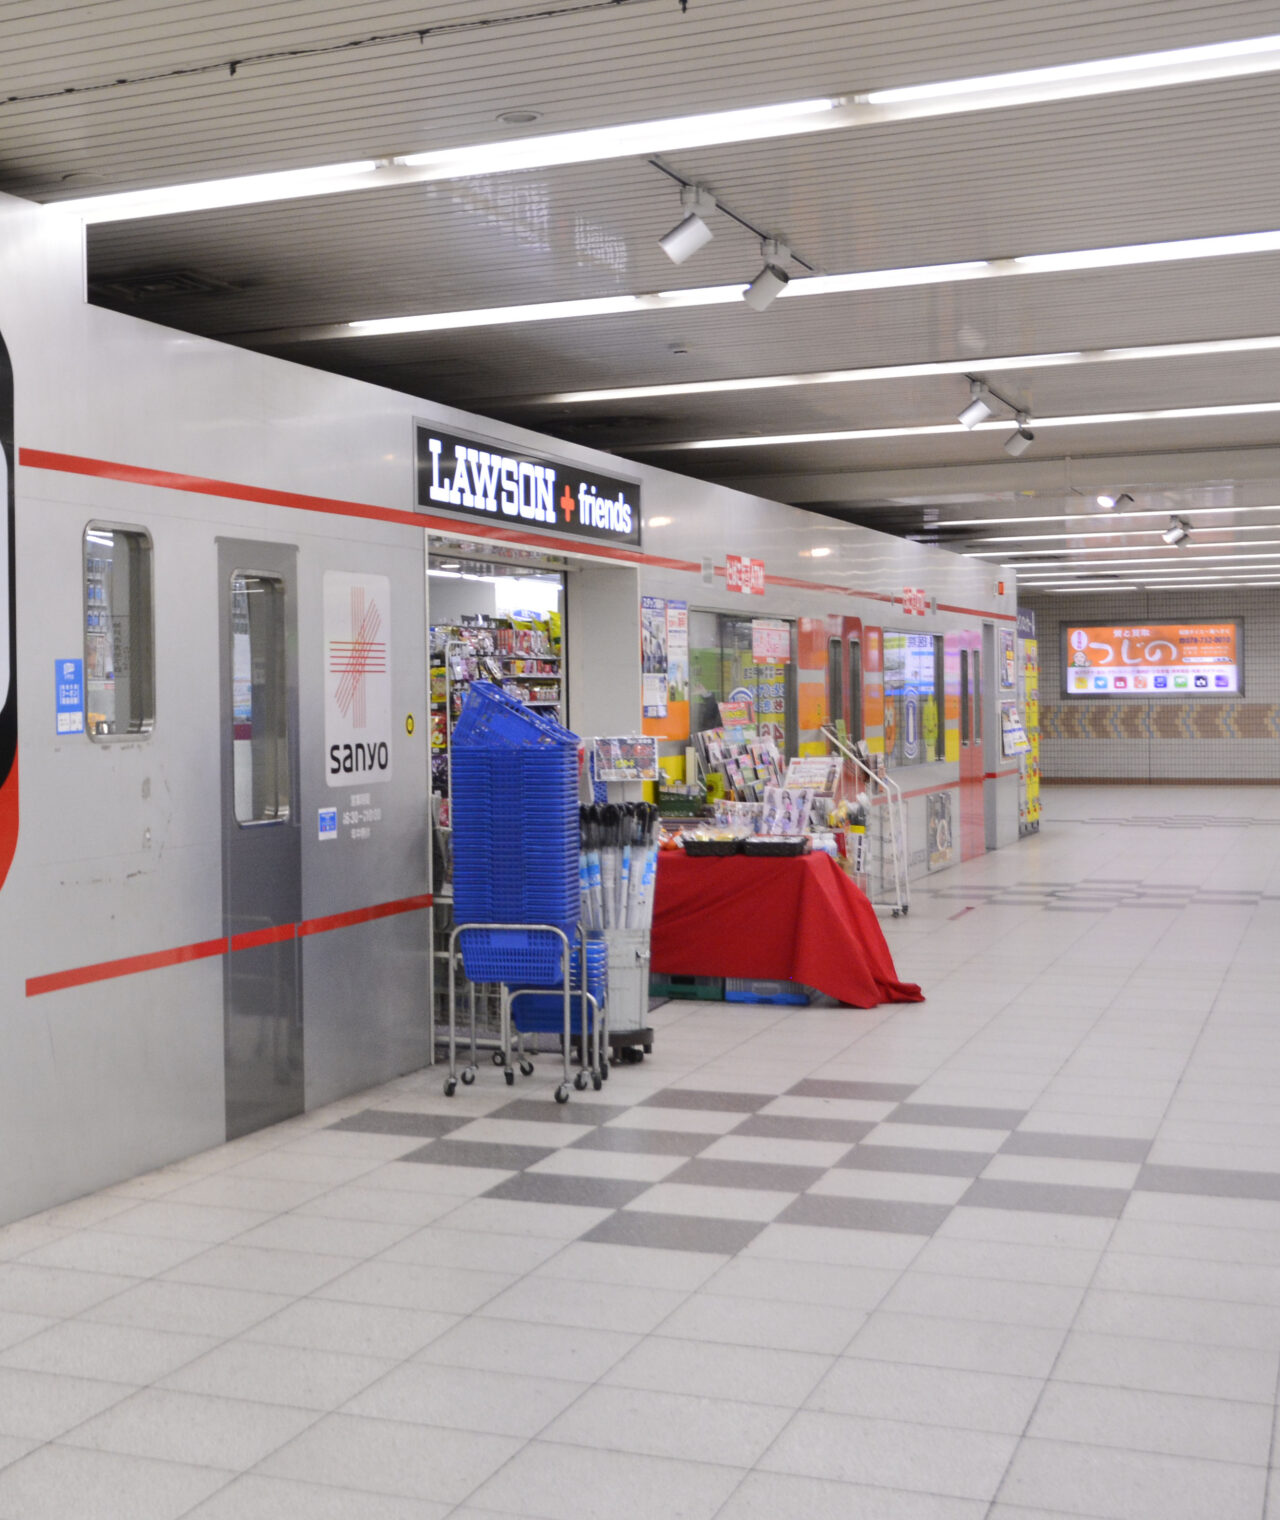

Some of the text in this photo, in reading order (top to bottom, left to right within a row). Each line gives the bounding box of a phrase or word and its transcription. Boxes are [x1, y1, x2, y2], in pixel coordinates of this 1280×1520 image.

[429, 438, 556, 524] LAWSON
[578, 483, 632, 534] friends
[1087, 638, 1177, 665] つじの
[330, 741, 388, 774] sanyo
